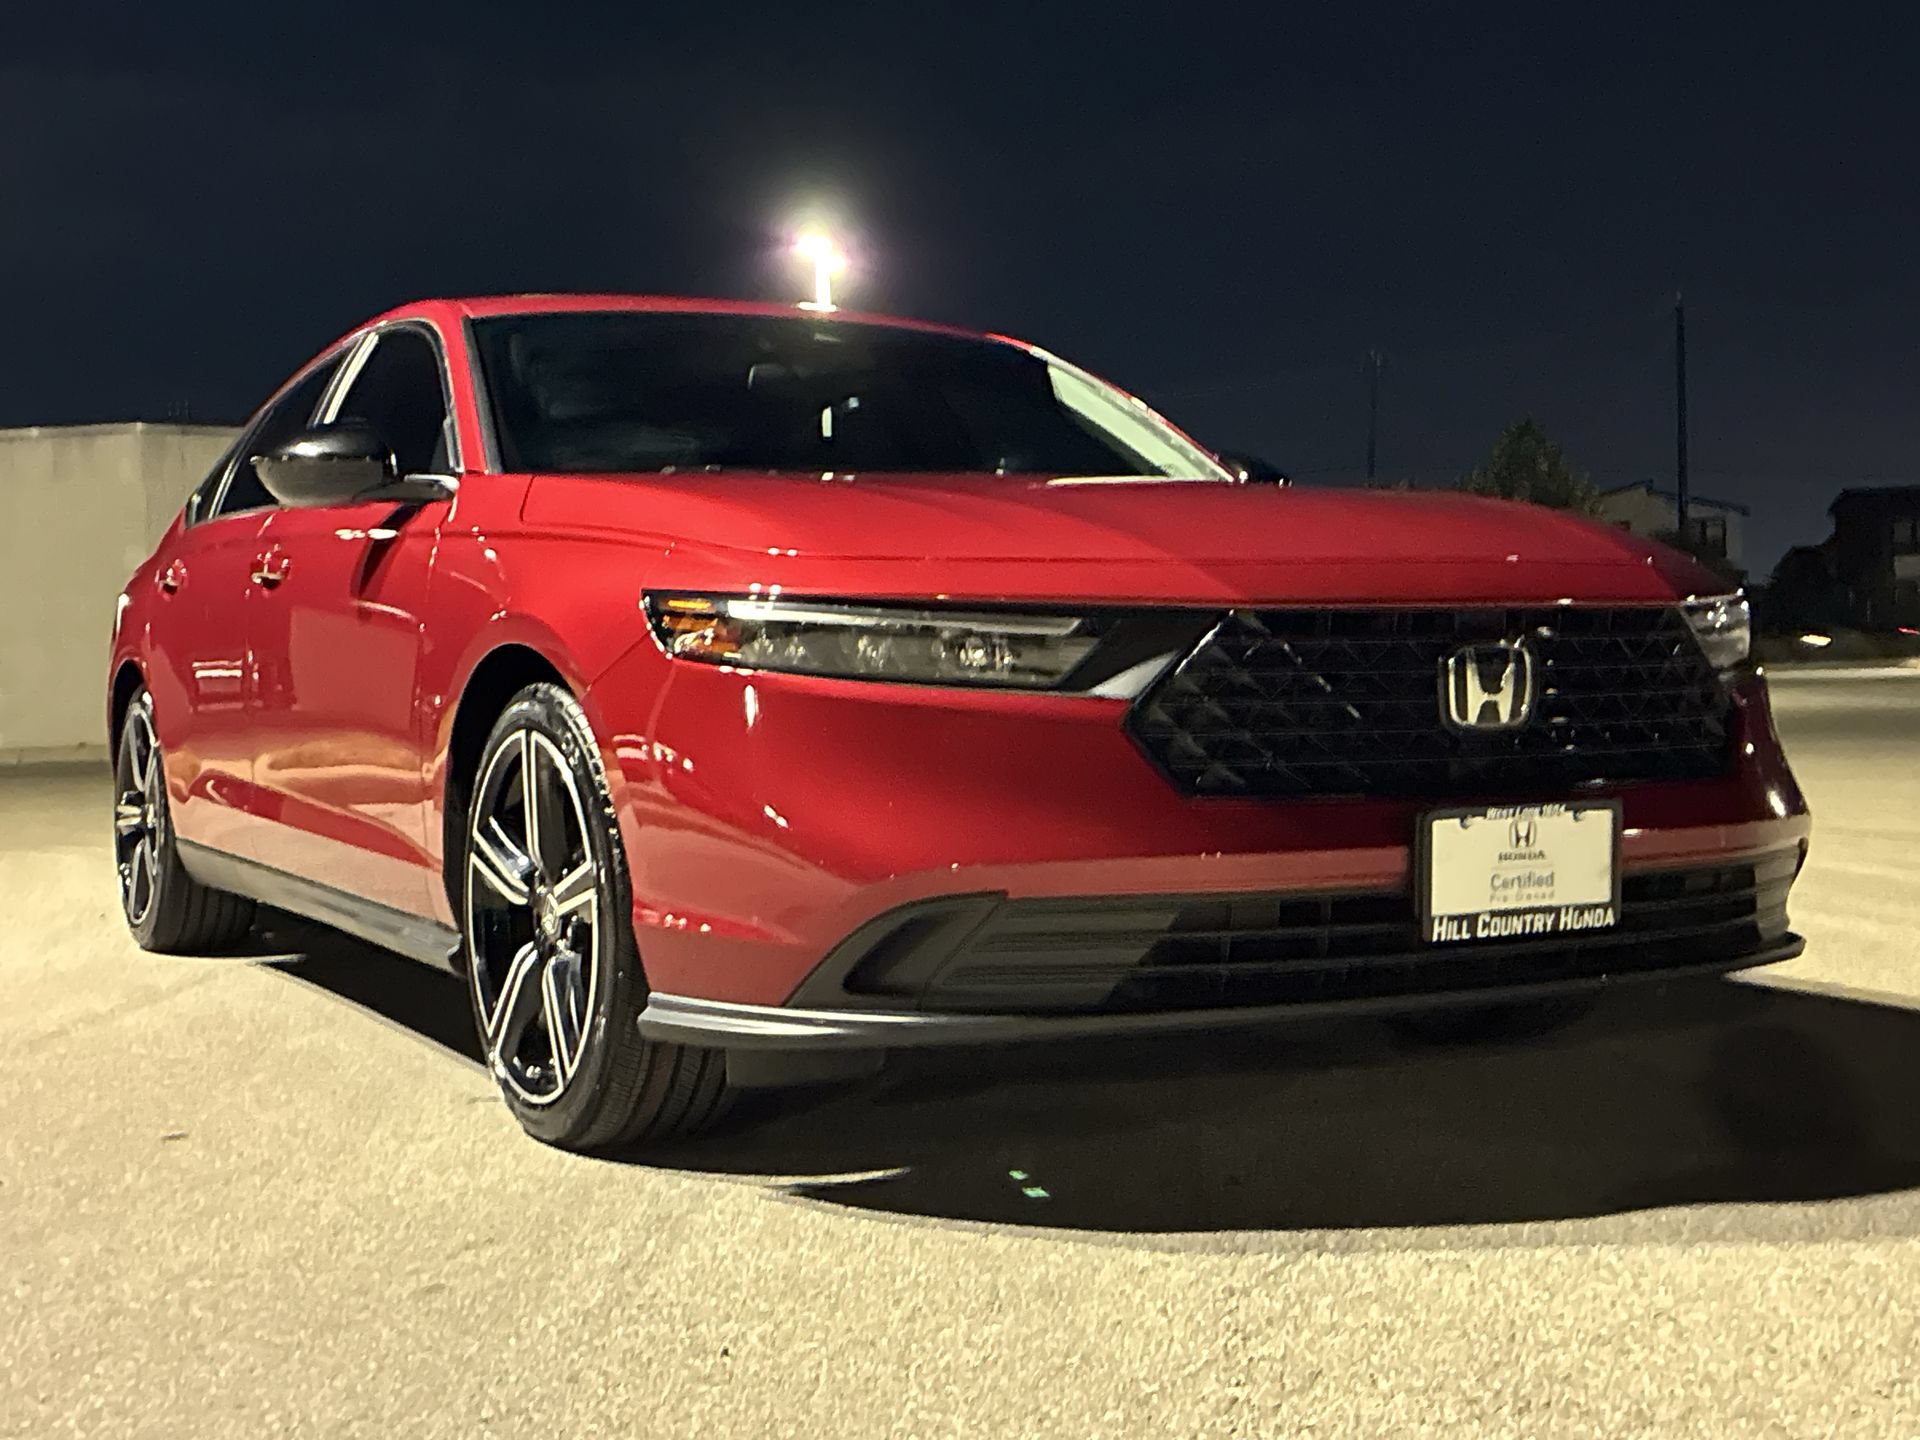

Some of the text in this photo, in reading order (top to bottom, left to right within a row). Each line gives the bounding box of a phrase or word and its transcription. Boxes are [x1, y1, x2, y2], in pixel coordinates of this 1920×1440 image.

[1498, 850, 1546, 863] HONDA
[1490, 870, 1555, 891] Certified
[1432, 916, 1471, 943] HILL
[1476, 912, 1556, 939] COUNTRY
